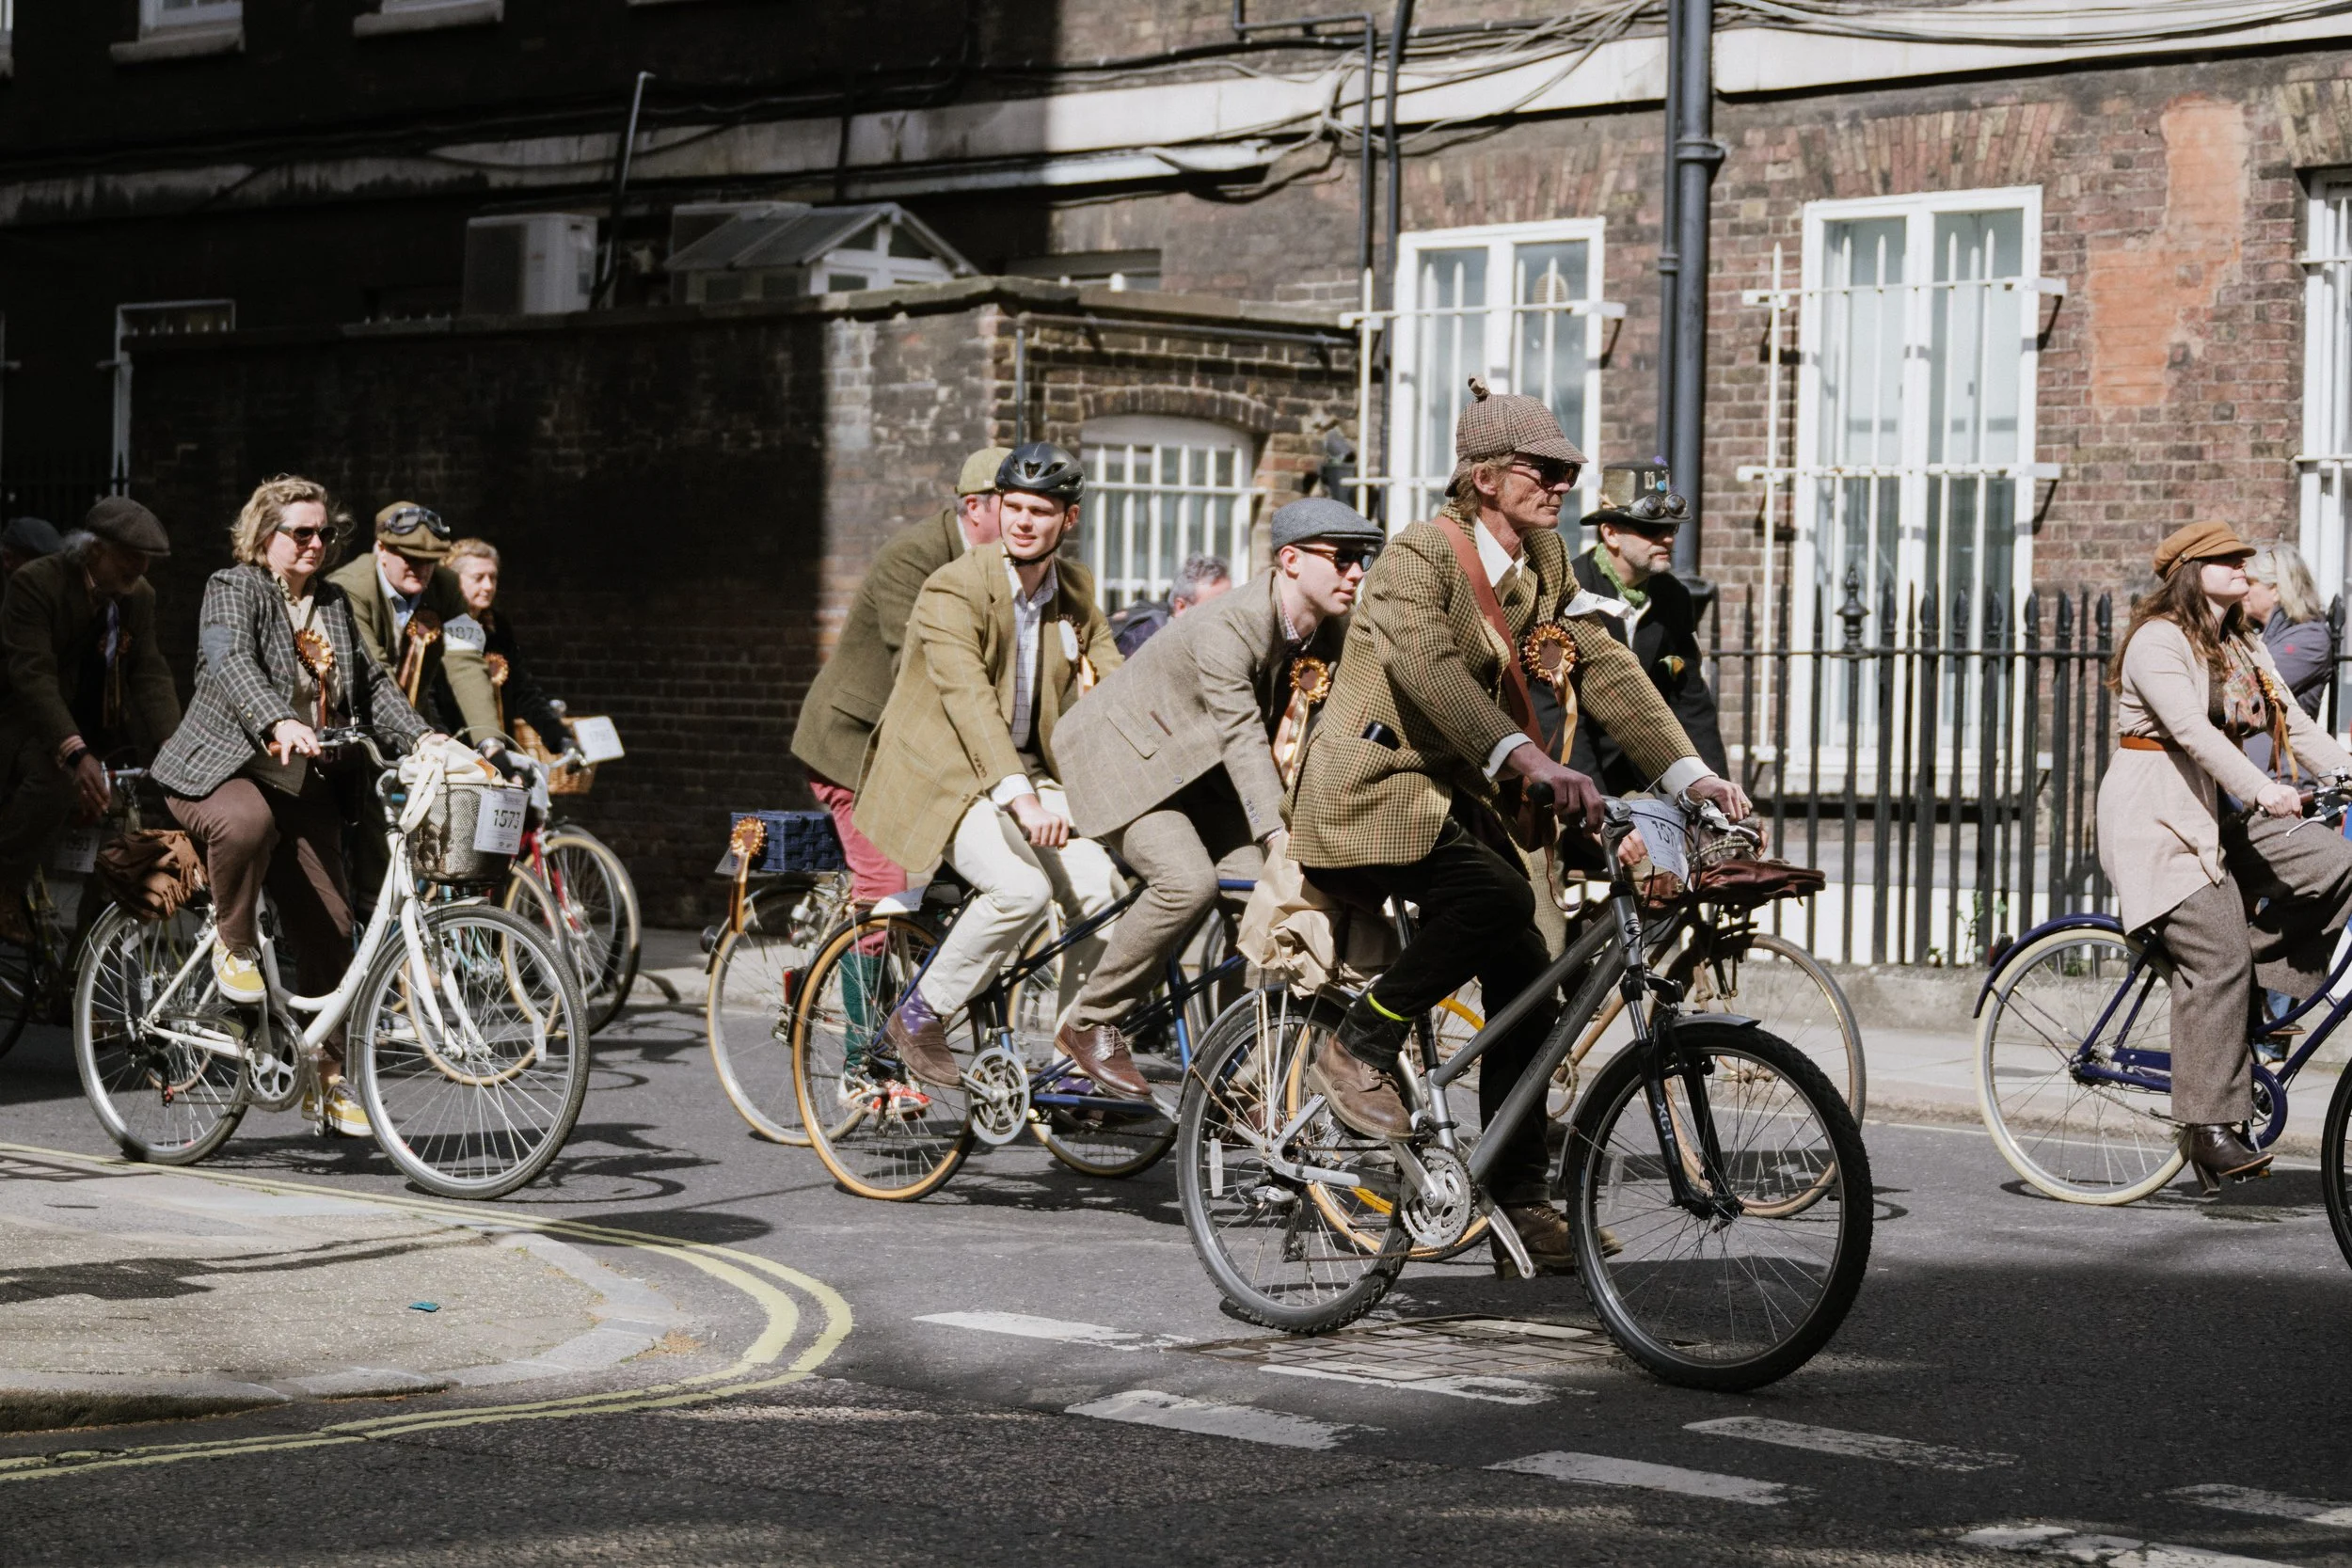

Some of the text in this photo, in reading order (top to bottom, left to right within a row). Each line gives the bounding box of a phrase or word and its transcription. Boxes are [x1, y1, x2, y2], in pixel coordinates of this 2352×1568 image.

[494, 809, 521, 829] 1573
[1524, 977, 1596, 1080] DAWES
[1657, 1101, 1676, 1143] XCT
